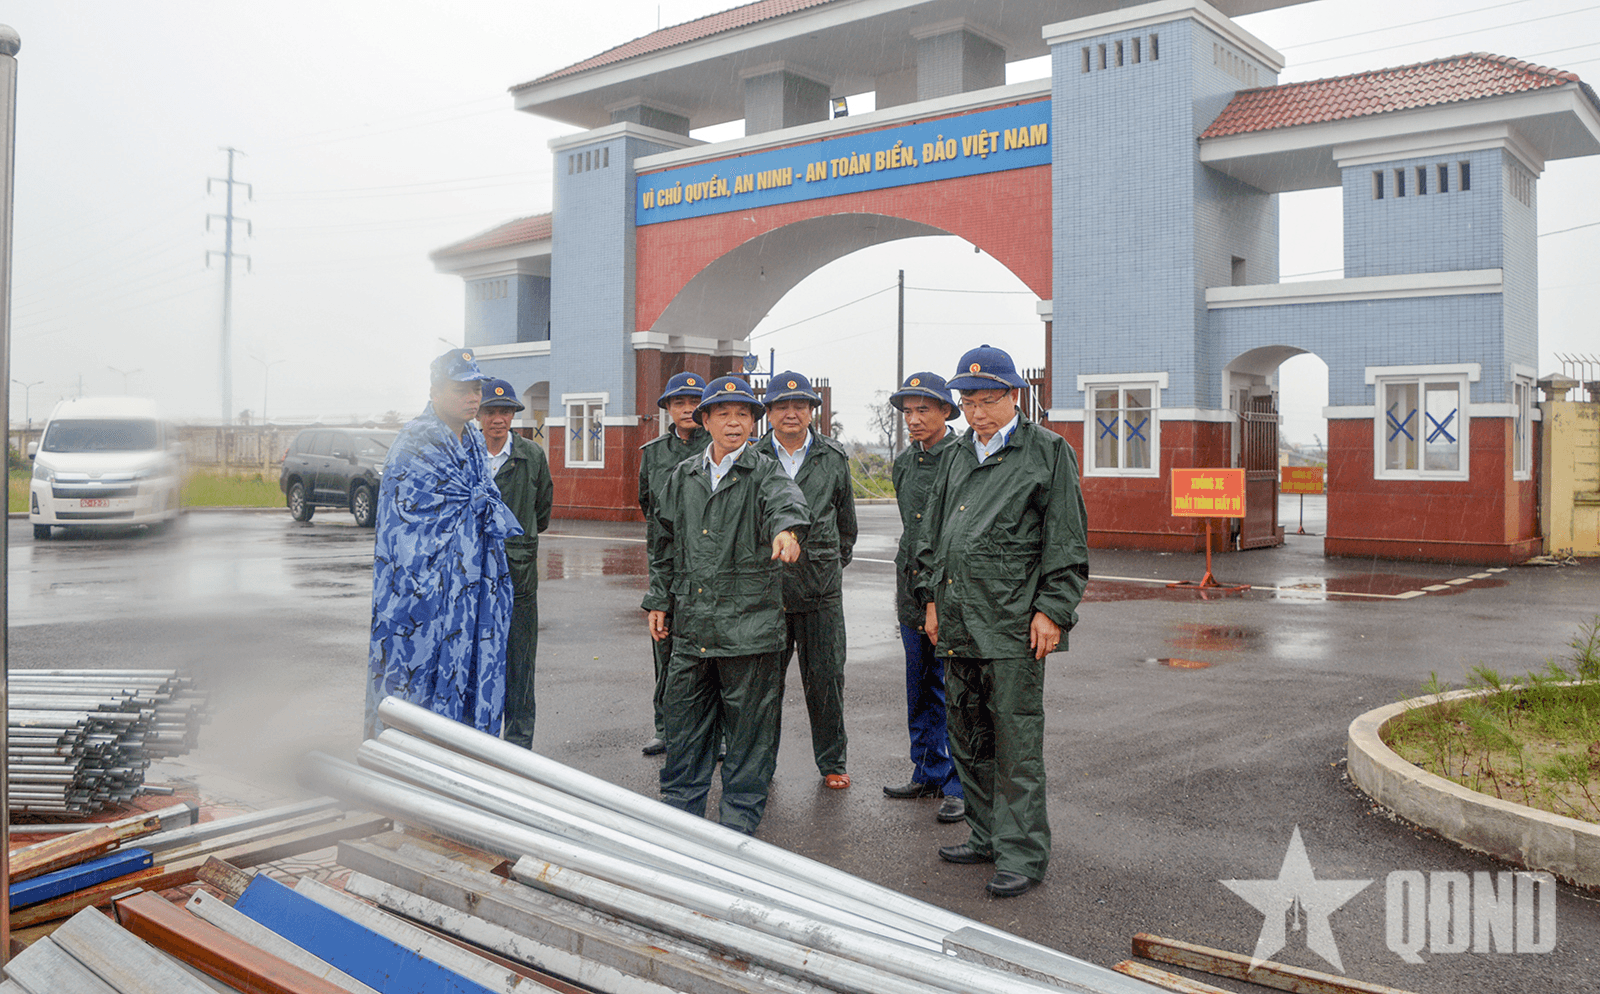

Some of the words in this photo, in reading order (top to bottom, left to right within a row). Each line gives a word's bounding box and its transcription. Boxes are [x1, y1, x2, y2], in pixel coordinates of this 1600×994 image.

[643, 188, 655, 209] VÌ
[657, 181, 682, 207] CHỦ
[734, 174, 754, 194] AN
[757, 167, 793, 190] NINH
[805, 161, 827, 183] AN
[830, 151, 871, 178] TOÀN
[875, 140, 918, 171] BIỂN,
[922, 134, 957, 163] ĐẢO
[961, 129, 1000, 158] VIỆT
[1004, 123, 1048, 150] NAM
